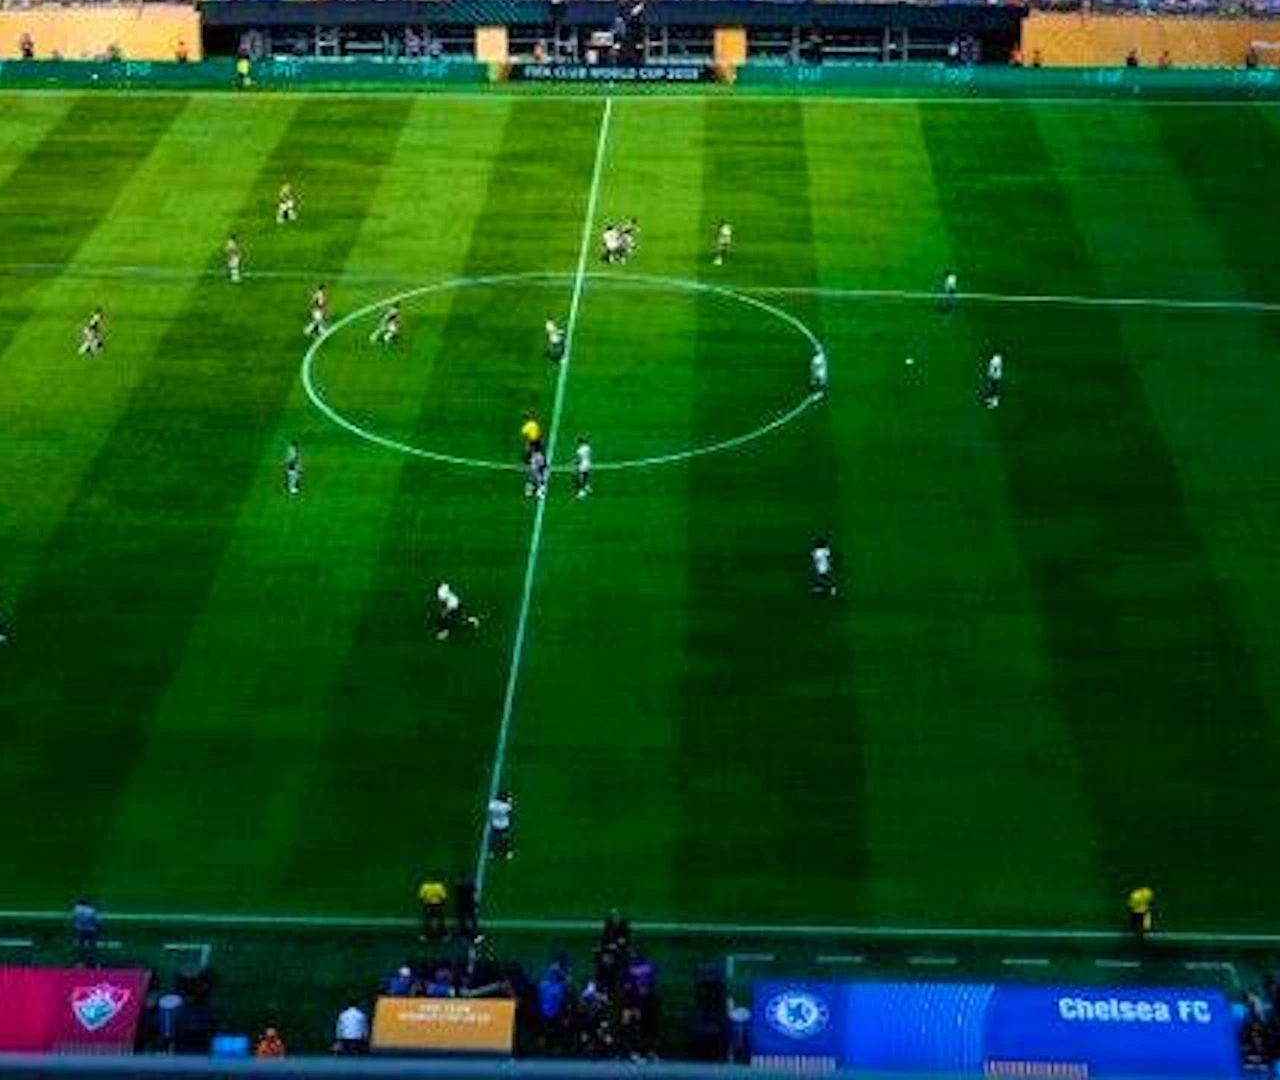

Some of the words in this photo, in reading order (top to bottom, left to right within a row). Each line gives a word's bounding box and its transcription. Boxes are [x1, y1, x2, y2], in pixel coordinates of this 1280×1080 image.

[590, 67, 637, 80] WORLD
[1058, 997, 1169, 1022] Chelsea
[1177, 1000, 1212, 1022] FC
